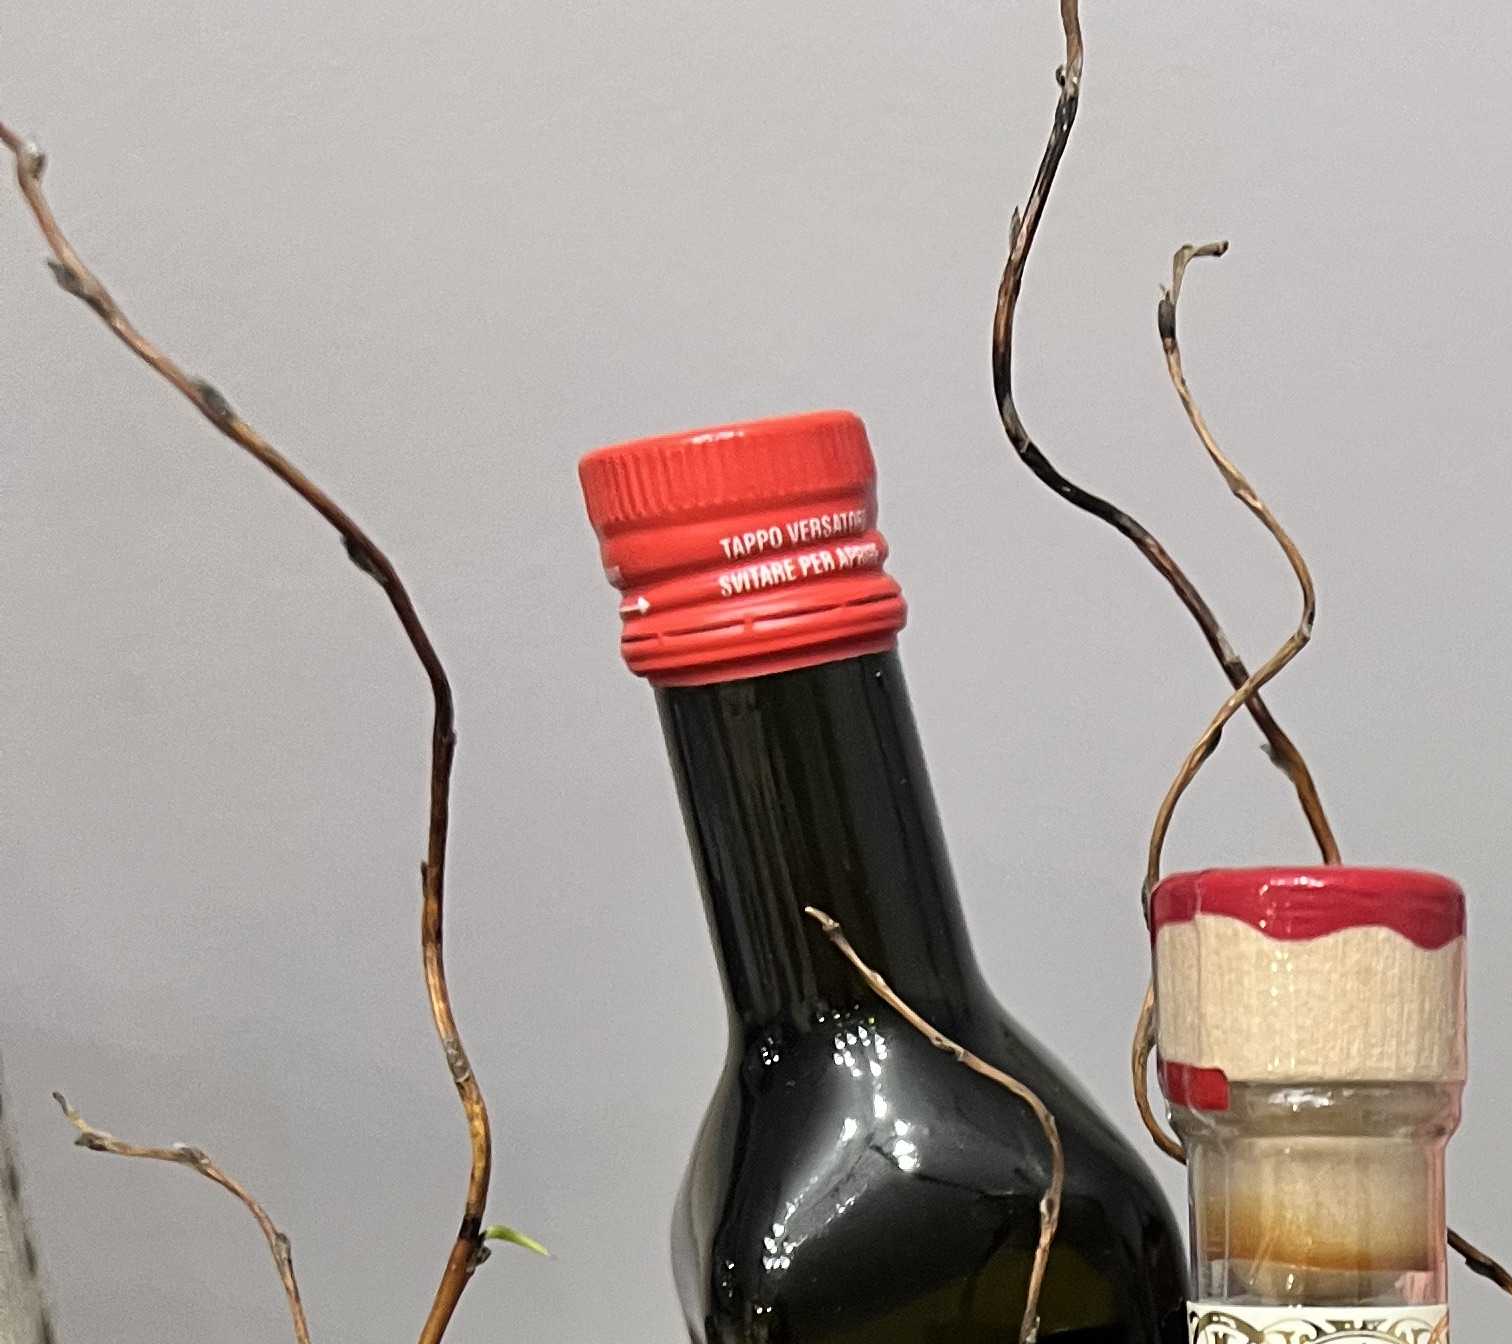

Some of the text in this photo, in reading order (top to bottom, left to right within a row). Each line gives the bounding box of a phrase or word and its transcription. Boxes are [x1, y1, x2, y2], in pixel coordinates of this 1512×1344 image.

[719, 526, 783, 560] TAPPO
[718, 557, 798, 597] SVITARE
[798, 550, 835, 578] PER
